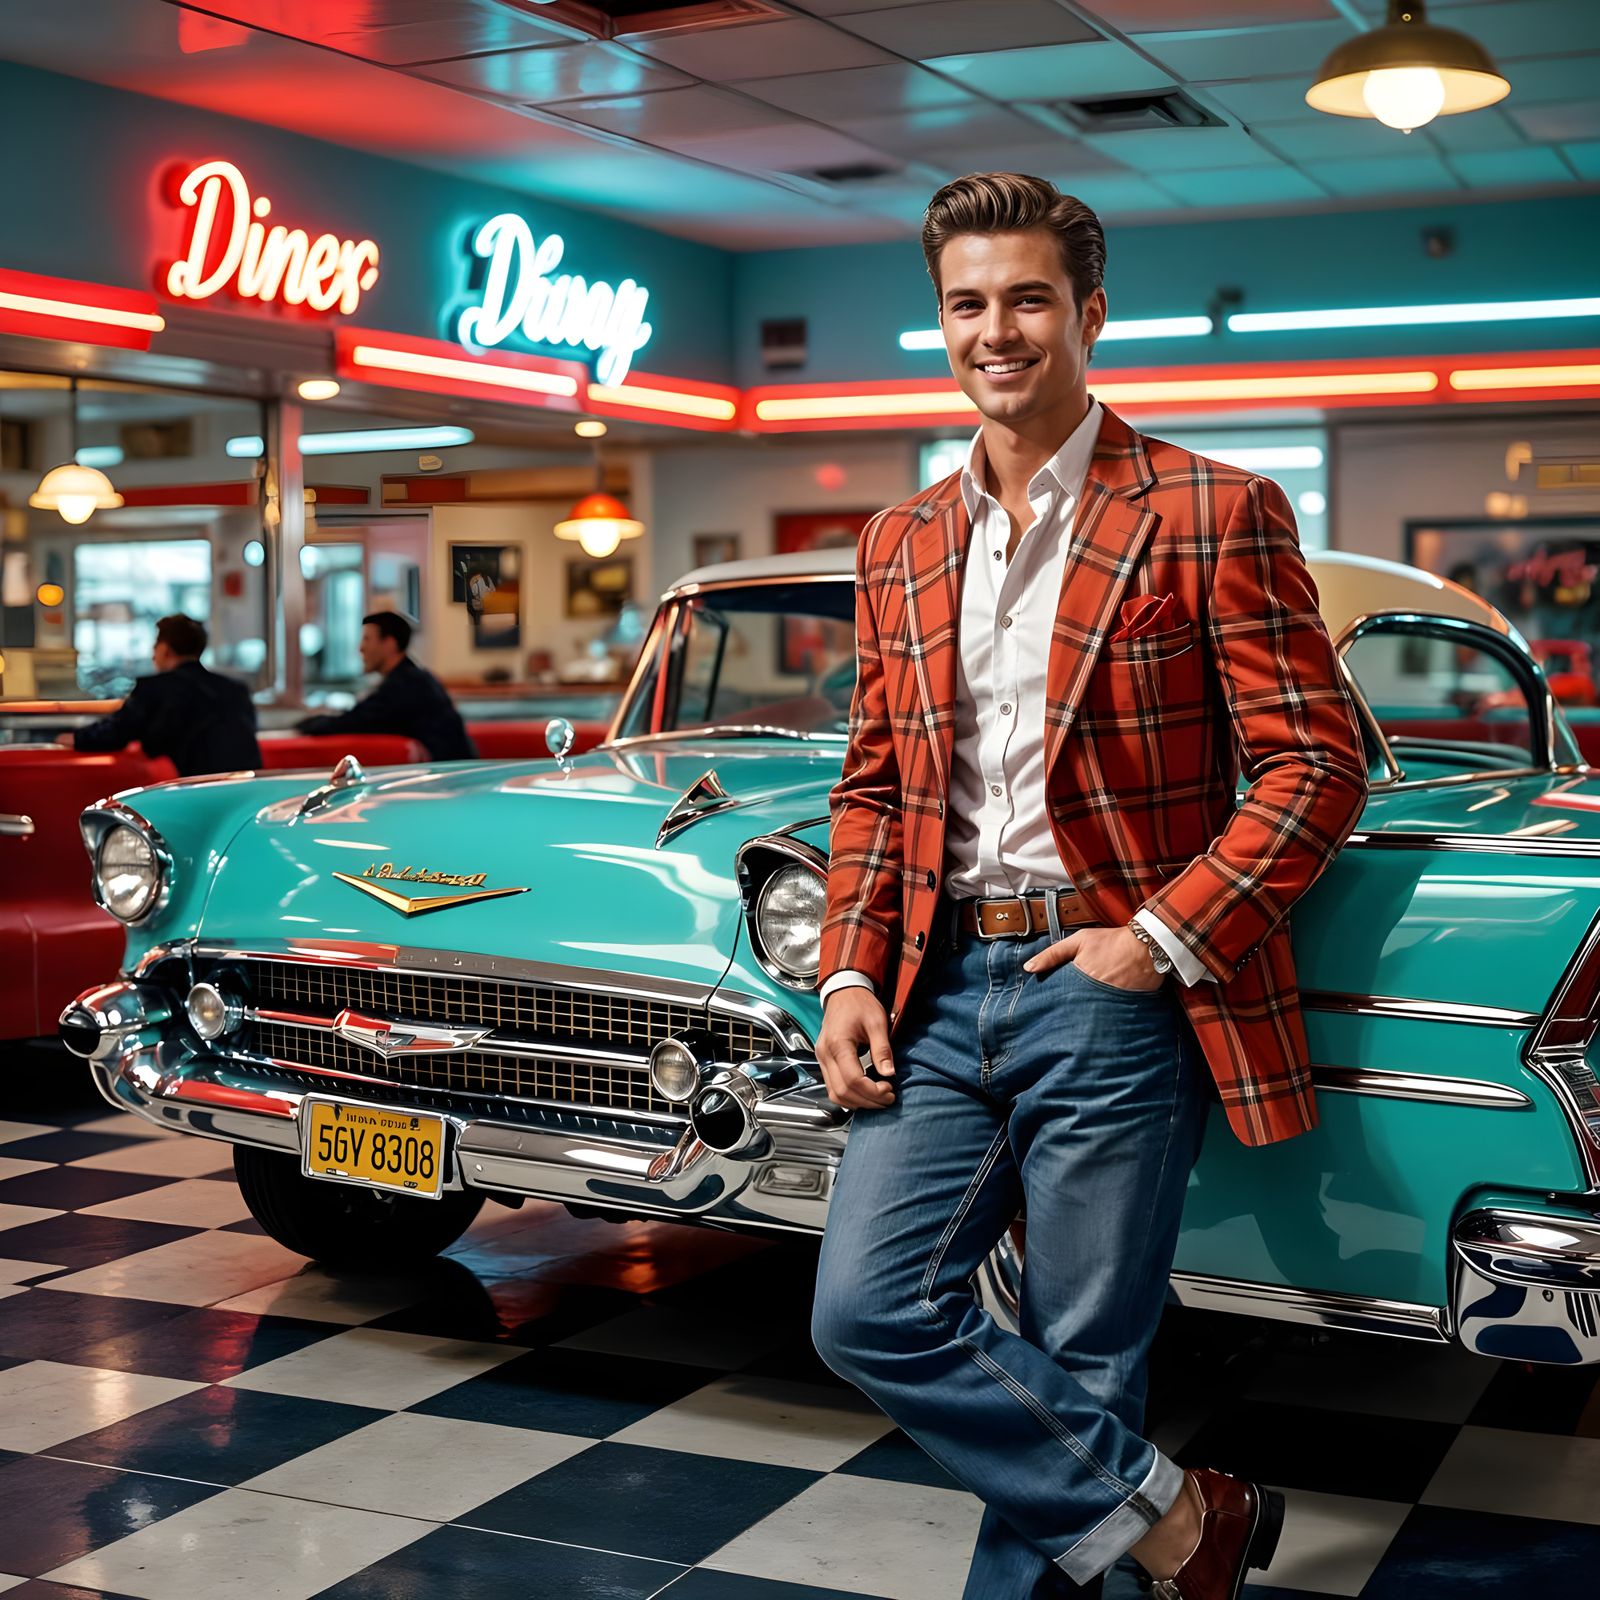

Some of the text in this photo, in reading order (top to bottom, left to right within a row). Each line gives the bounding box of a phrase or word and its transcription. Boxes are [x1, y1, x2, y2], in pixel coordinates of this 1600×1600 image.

[167, 160, 379, 315] Diner
[318, 1123, 435, 1179] 5GY 8308
